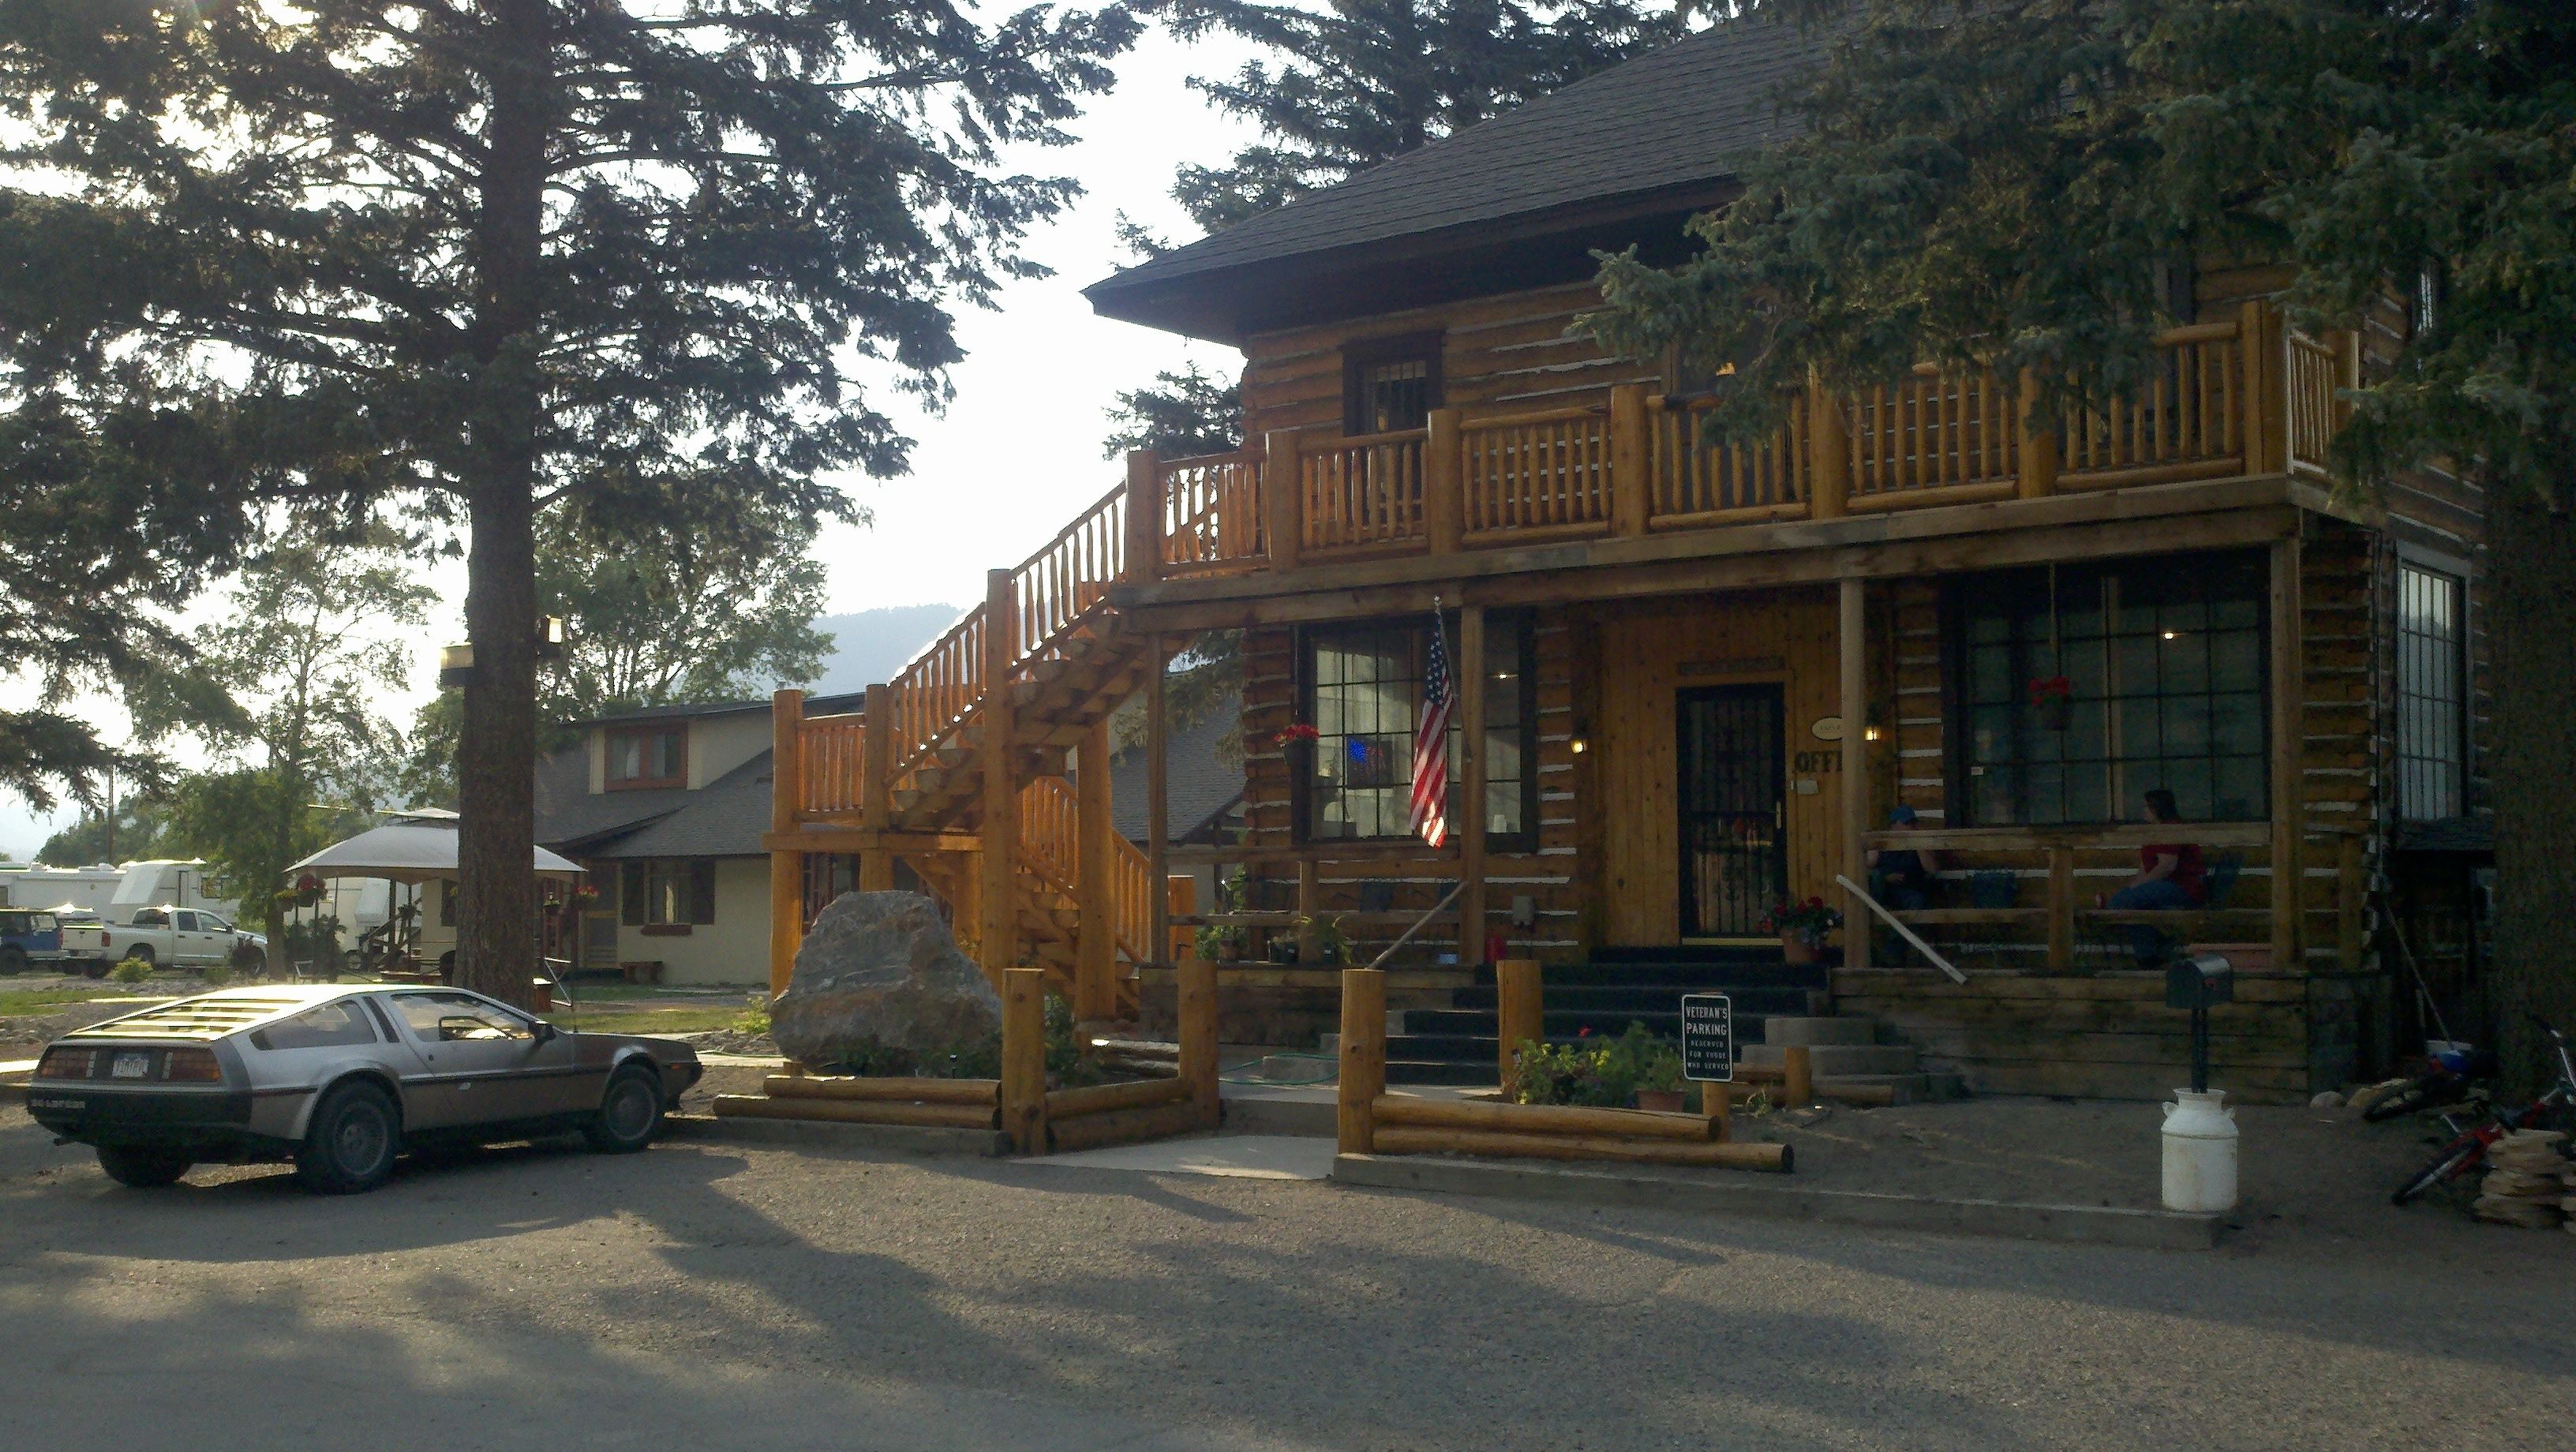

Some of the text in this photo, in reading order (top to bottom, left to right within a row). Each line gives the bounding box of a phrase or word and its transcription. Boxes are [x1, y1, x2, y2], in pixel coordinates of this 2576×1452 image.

[1686, 1006, 1728, 1020] VETERAN'S
[1686, 1023, 1727, 1035] PARKING
[1689, 1050, 1727, 1060] FOR THOSE
